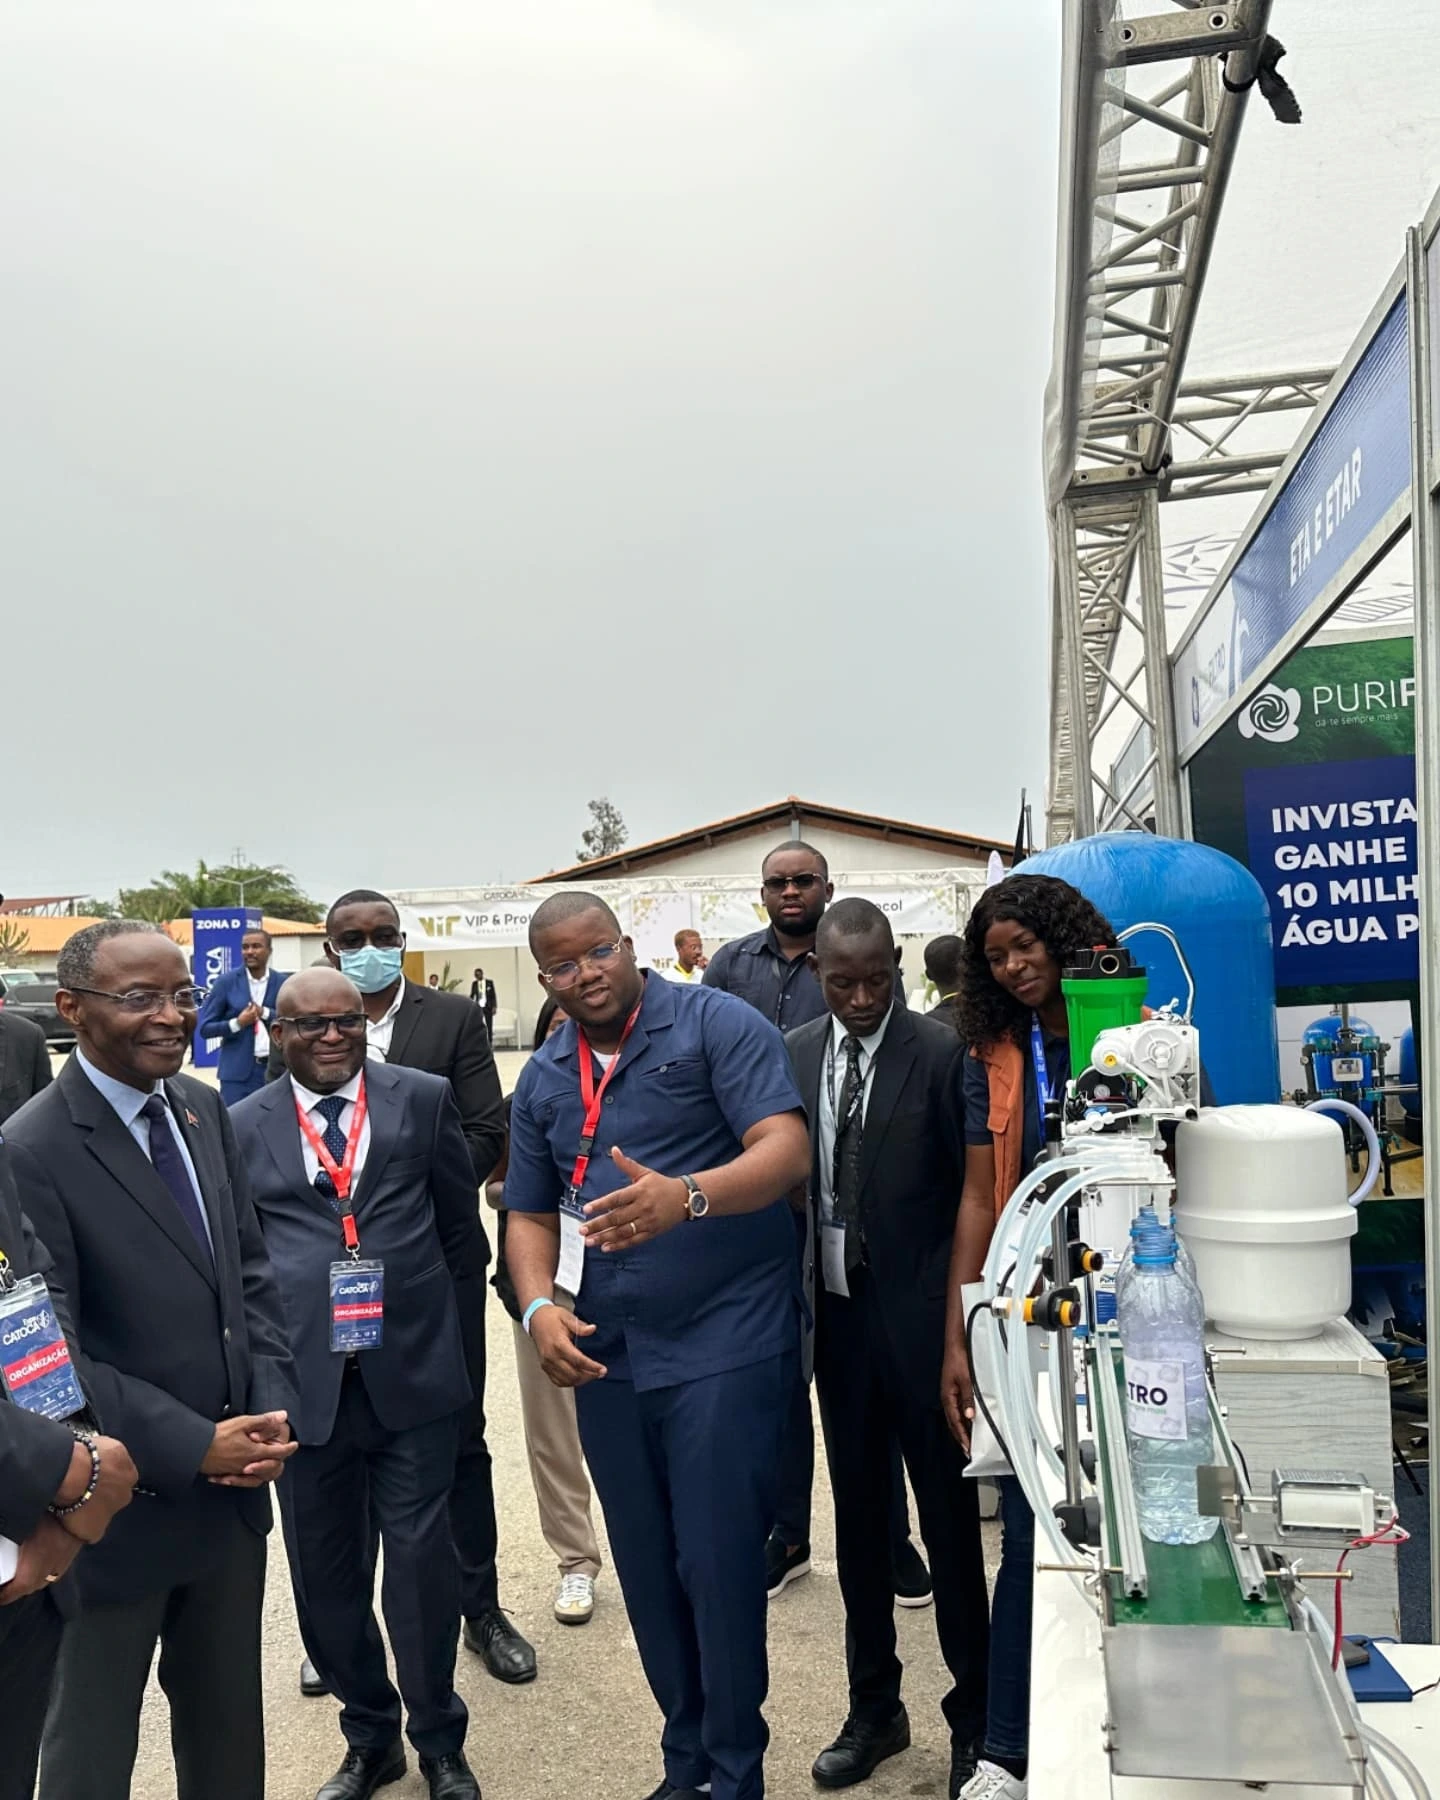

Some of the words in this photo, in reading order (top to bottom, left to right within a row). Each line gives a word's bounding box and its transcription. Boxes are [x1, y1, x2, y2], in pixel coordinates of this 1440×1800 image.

[1290, 521, 1311, 588] ETA
[1314, 500, 1322, 556] E
[1325, 446, 1361, 540] ETAR
[1341, 713, 1375, 726] sempre
[1377, 712, 1399, 721] mais
[1271, 797, 1418, 833] INVISTA
[1274, 836, 1408, 871] GANHE
[1276, 882, 1319, 909] 10
[1329, 875, 1419, 906] MILH
[196, 919, 230, 930] ZONA
[231, 918, 241, 929] D
[465, 915, 489, 927] VIP
[492, 915, 501, 926] &
[1280, 914, 1389, 948] ÁGUA
[1396, 913, 1420, 940] P
[206, 946, 224, 991] OCA
[3, 1322, 41, 1346] CATOCA
[9, 1345, 69, 1382] ORGANIZAÇÃO
[1128, 1381, 1168, 1406] TRO
